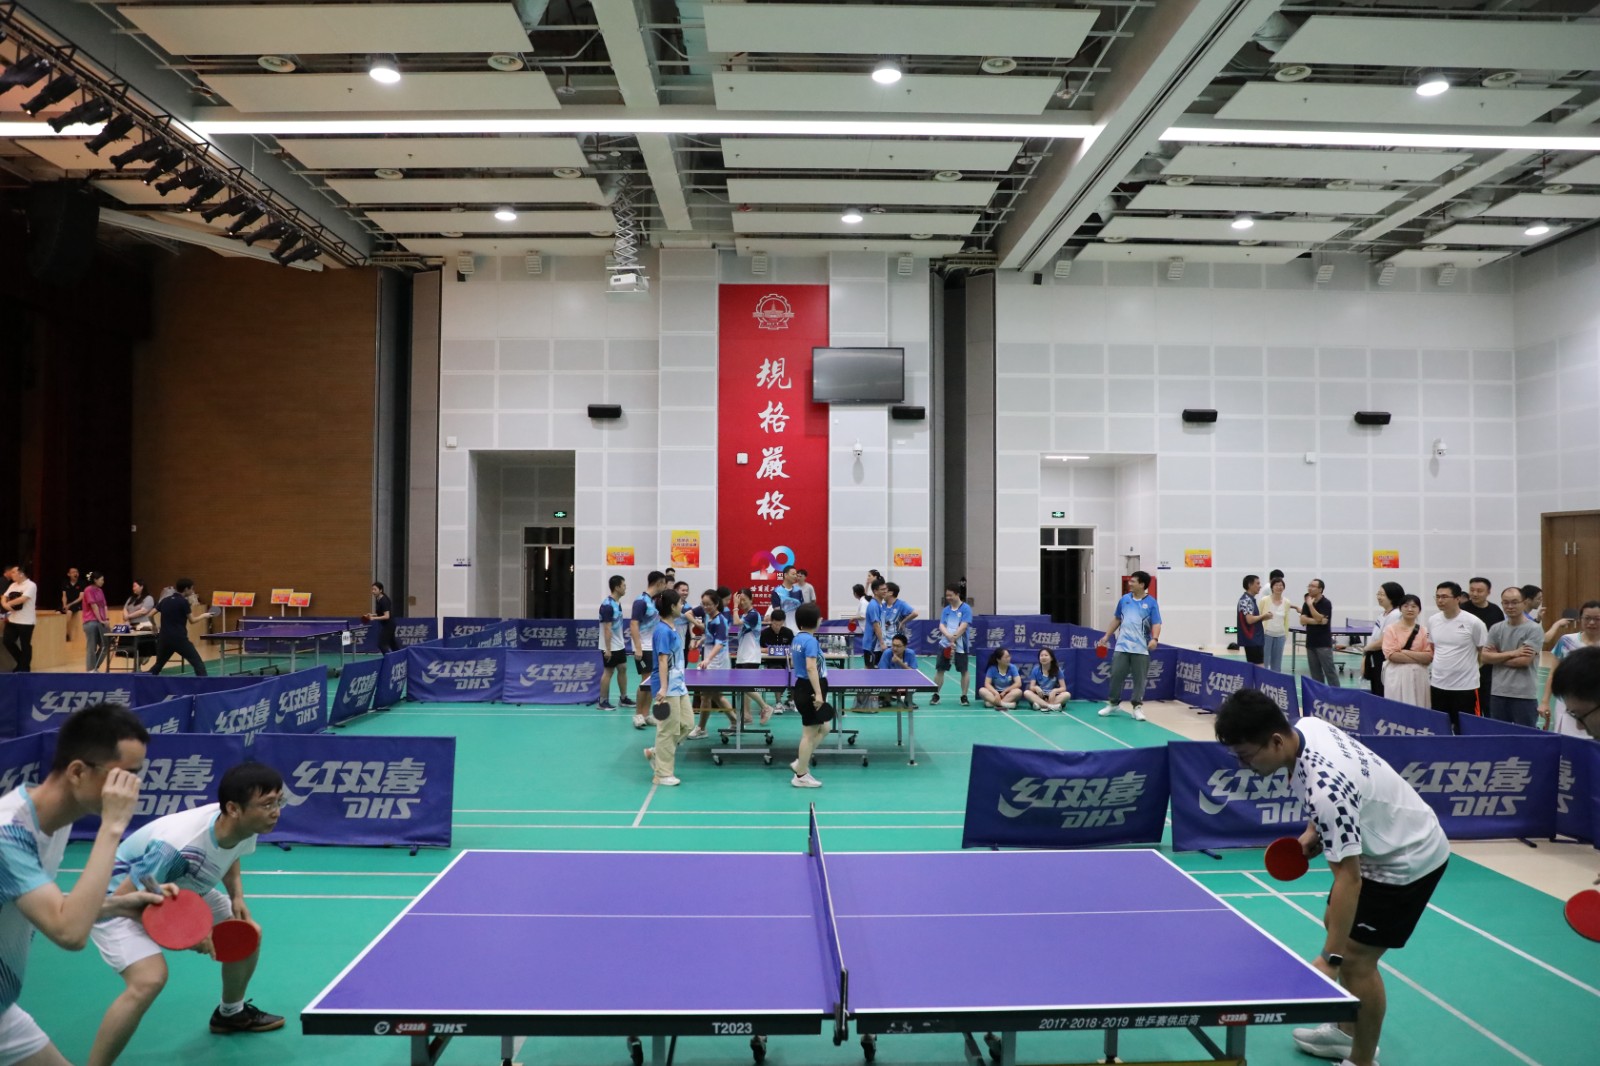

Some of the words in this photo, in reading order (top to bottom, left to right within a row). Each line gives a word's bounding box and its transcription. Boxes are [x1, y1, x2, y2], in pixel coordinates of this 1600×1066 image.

[520, 626, 568, 642] 红双喜
[421, 658, 498, 684] 红双喜
[519, 661, 597, 687] 红双喜
[454, 678, 495, 690] DHS
[552, 681, 594, 693] DHS
[277, 681, 321, 724] 红双喜
[212, 698, 271, 734] 红双喜
[295, 706, 319, 726] DHS
[282, 757, 428, 806] 红双喜
[1400, 756, 1532, 793] 红双喜
[998, 770, 1148, 818] 红双喜
[342, 797, 421, 819] DHS
[1256, 801, 1311, 825] DH
[1449, 795, 1527, 817] DHS
[1060, 806, 1137, 829] DHS
[432, 1023, 467, 1034] DHS
[711, 1022, 753, 1035] T2023
[1134, 1014, 1200, 1027] 世乒赛供应商
[1253, 1012, 1287, 1024] DHS
